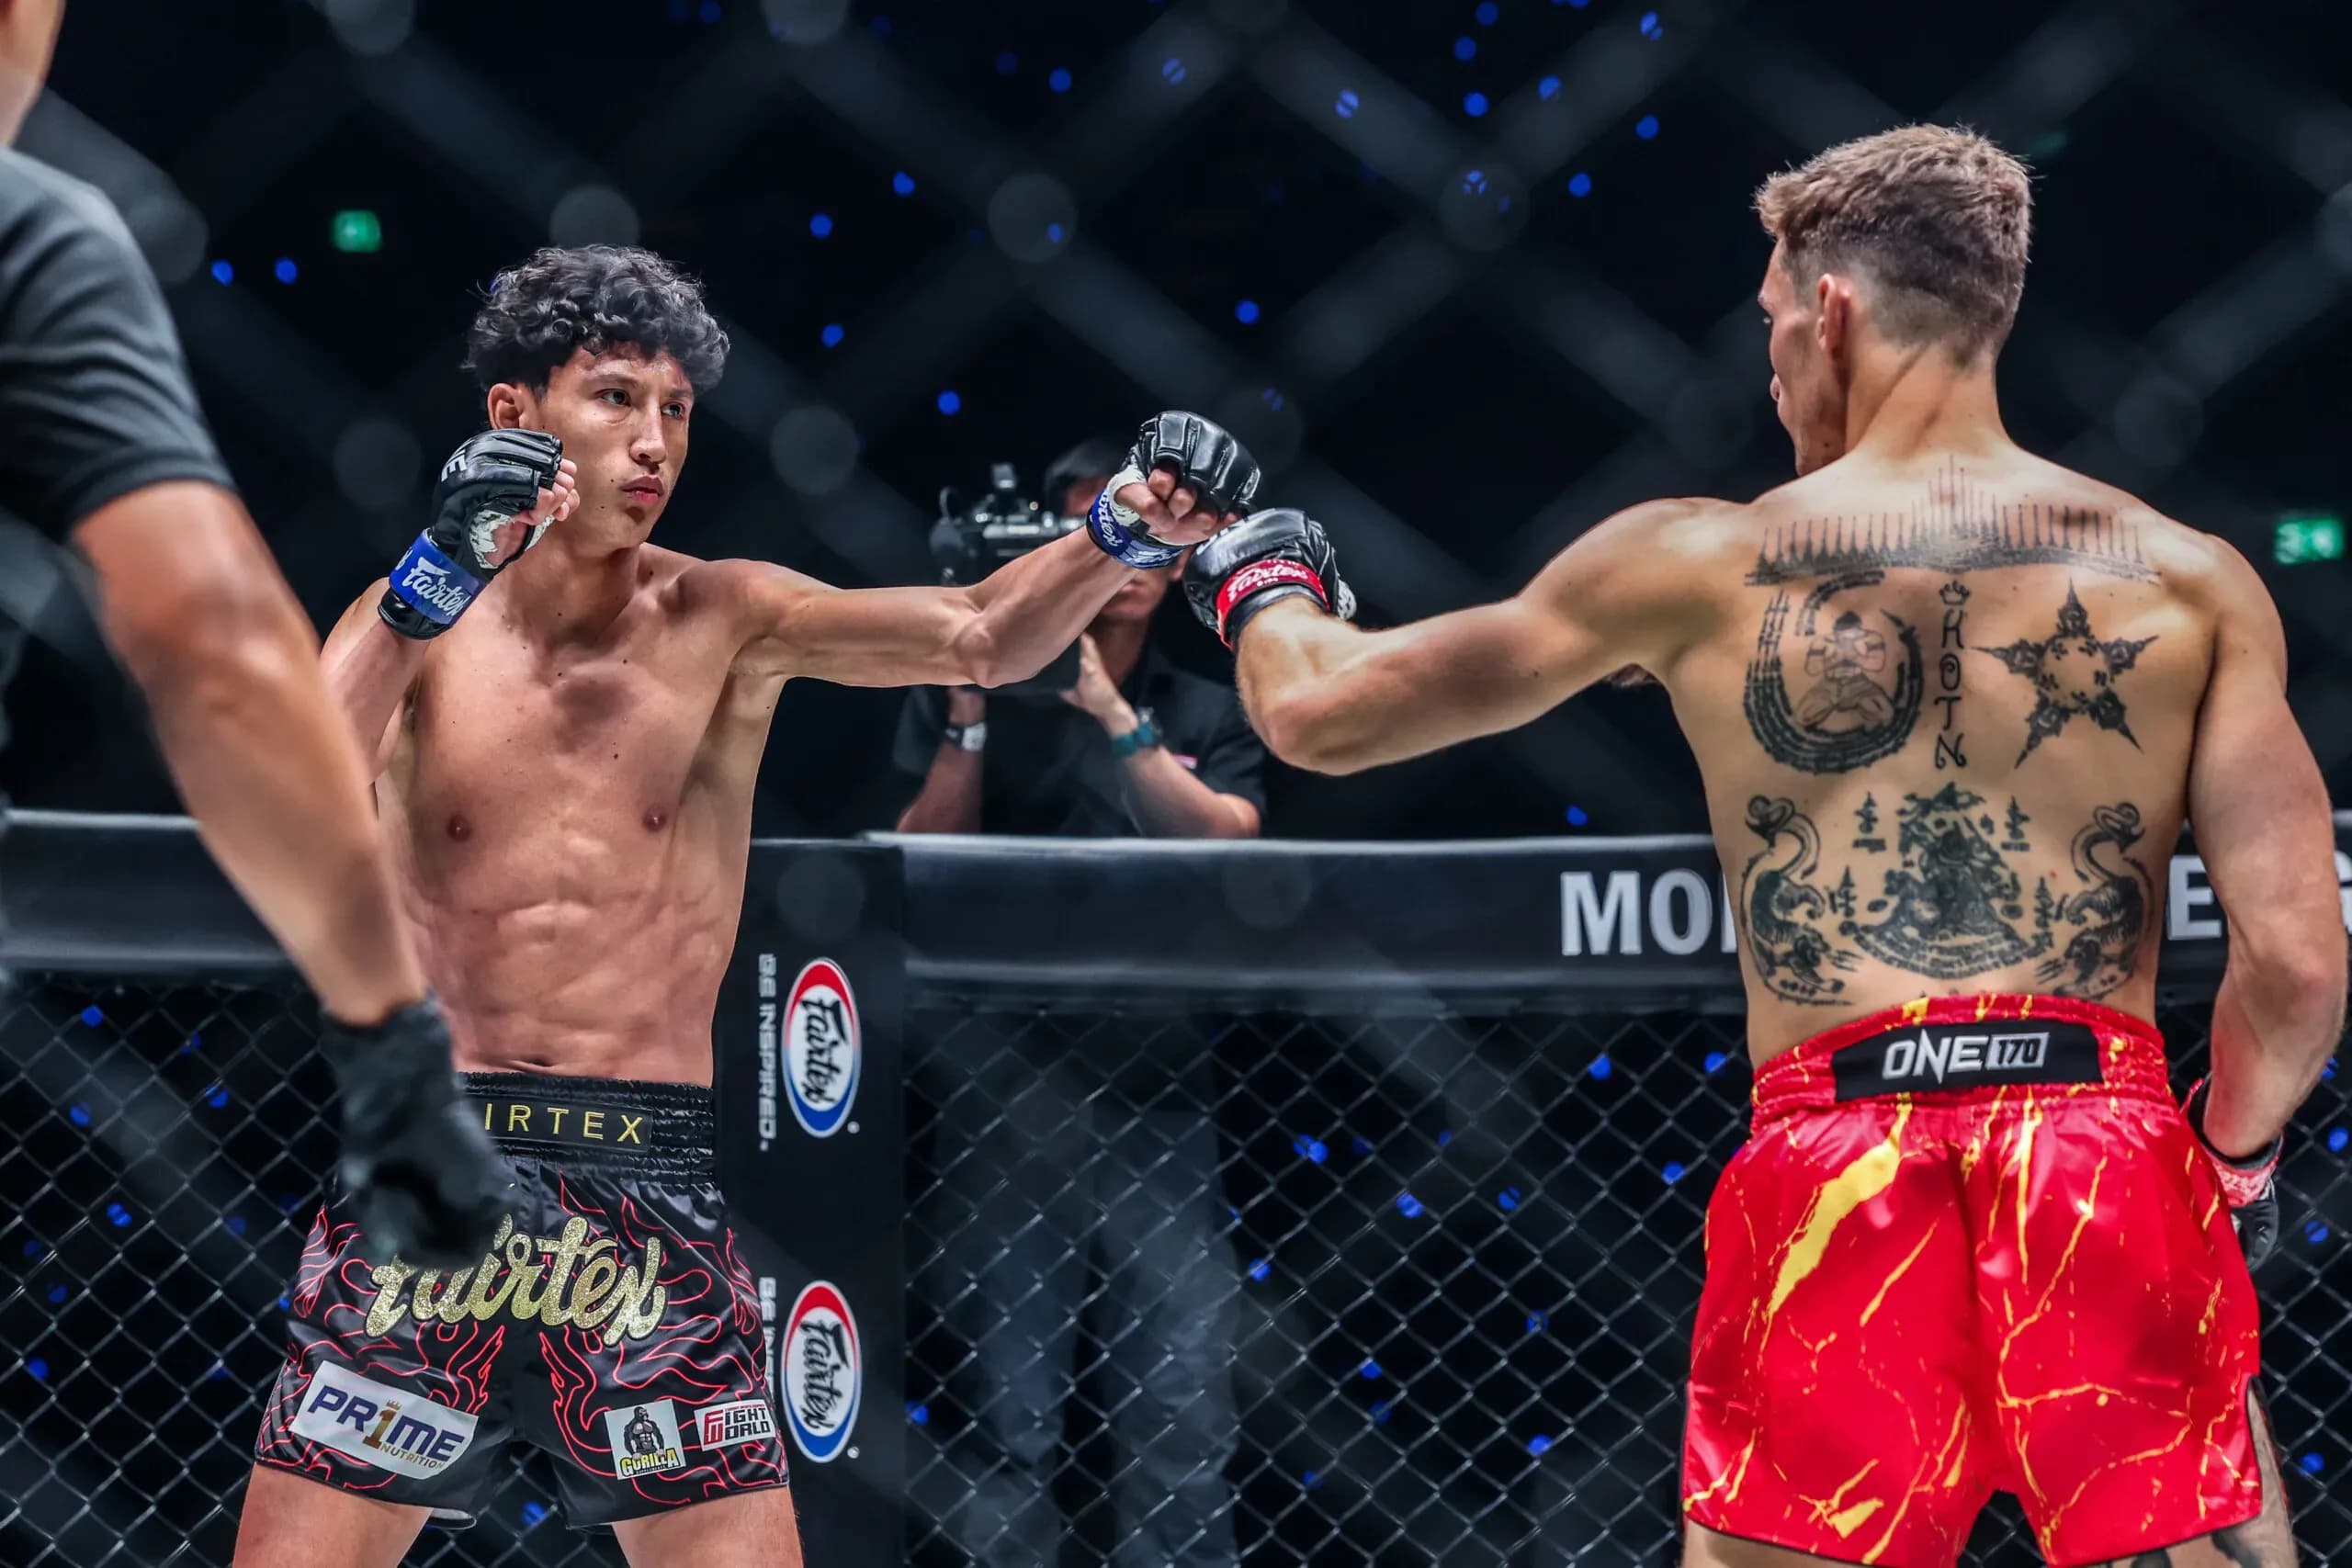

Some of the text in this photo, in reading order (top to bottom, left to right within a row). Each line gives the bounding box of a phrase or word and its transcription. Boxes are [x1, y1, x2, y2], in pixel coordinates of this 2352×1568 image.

[401, 557, 472, 616] Fairtex
[800, 998, 849, 1105] Fairtex
[1883, 1029, 2042, 1085] ONE 170
[484, 1102, 644, 1145] IRTEX
[800, 1319, 851, 1429] Fairtex
[379, 1445, 446, 1470] NUTRITION
